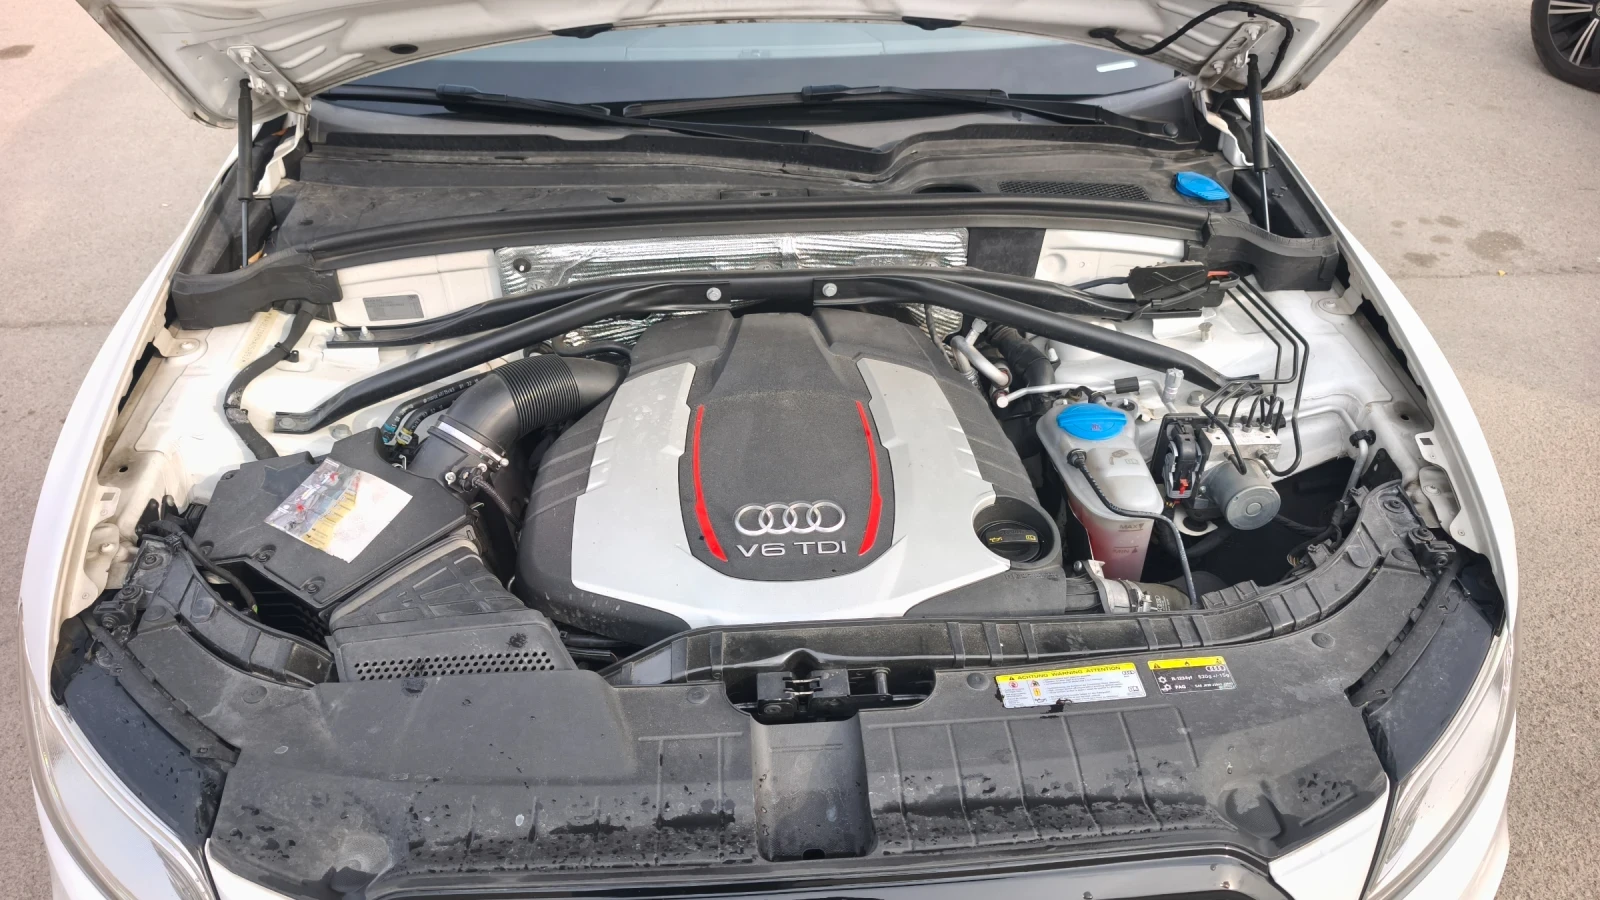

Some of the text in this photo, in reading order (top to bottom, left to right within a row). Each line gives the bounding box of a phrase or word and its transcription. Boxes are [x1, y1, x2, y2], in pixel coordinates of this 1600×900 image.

[736, 540, 847, 557] V6 TDI
[1051, 669, 1083, 677] WARNING
